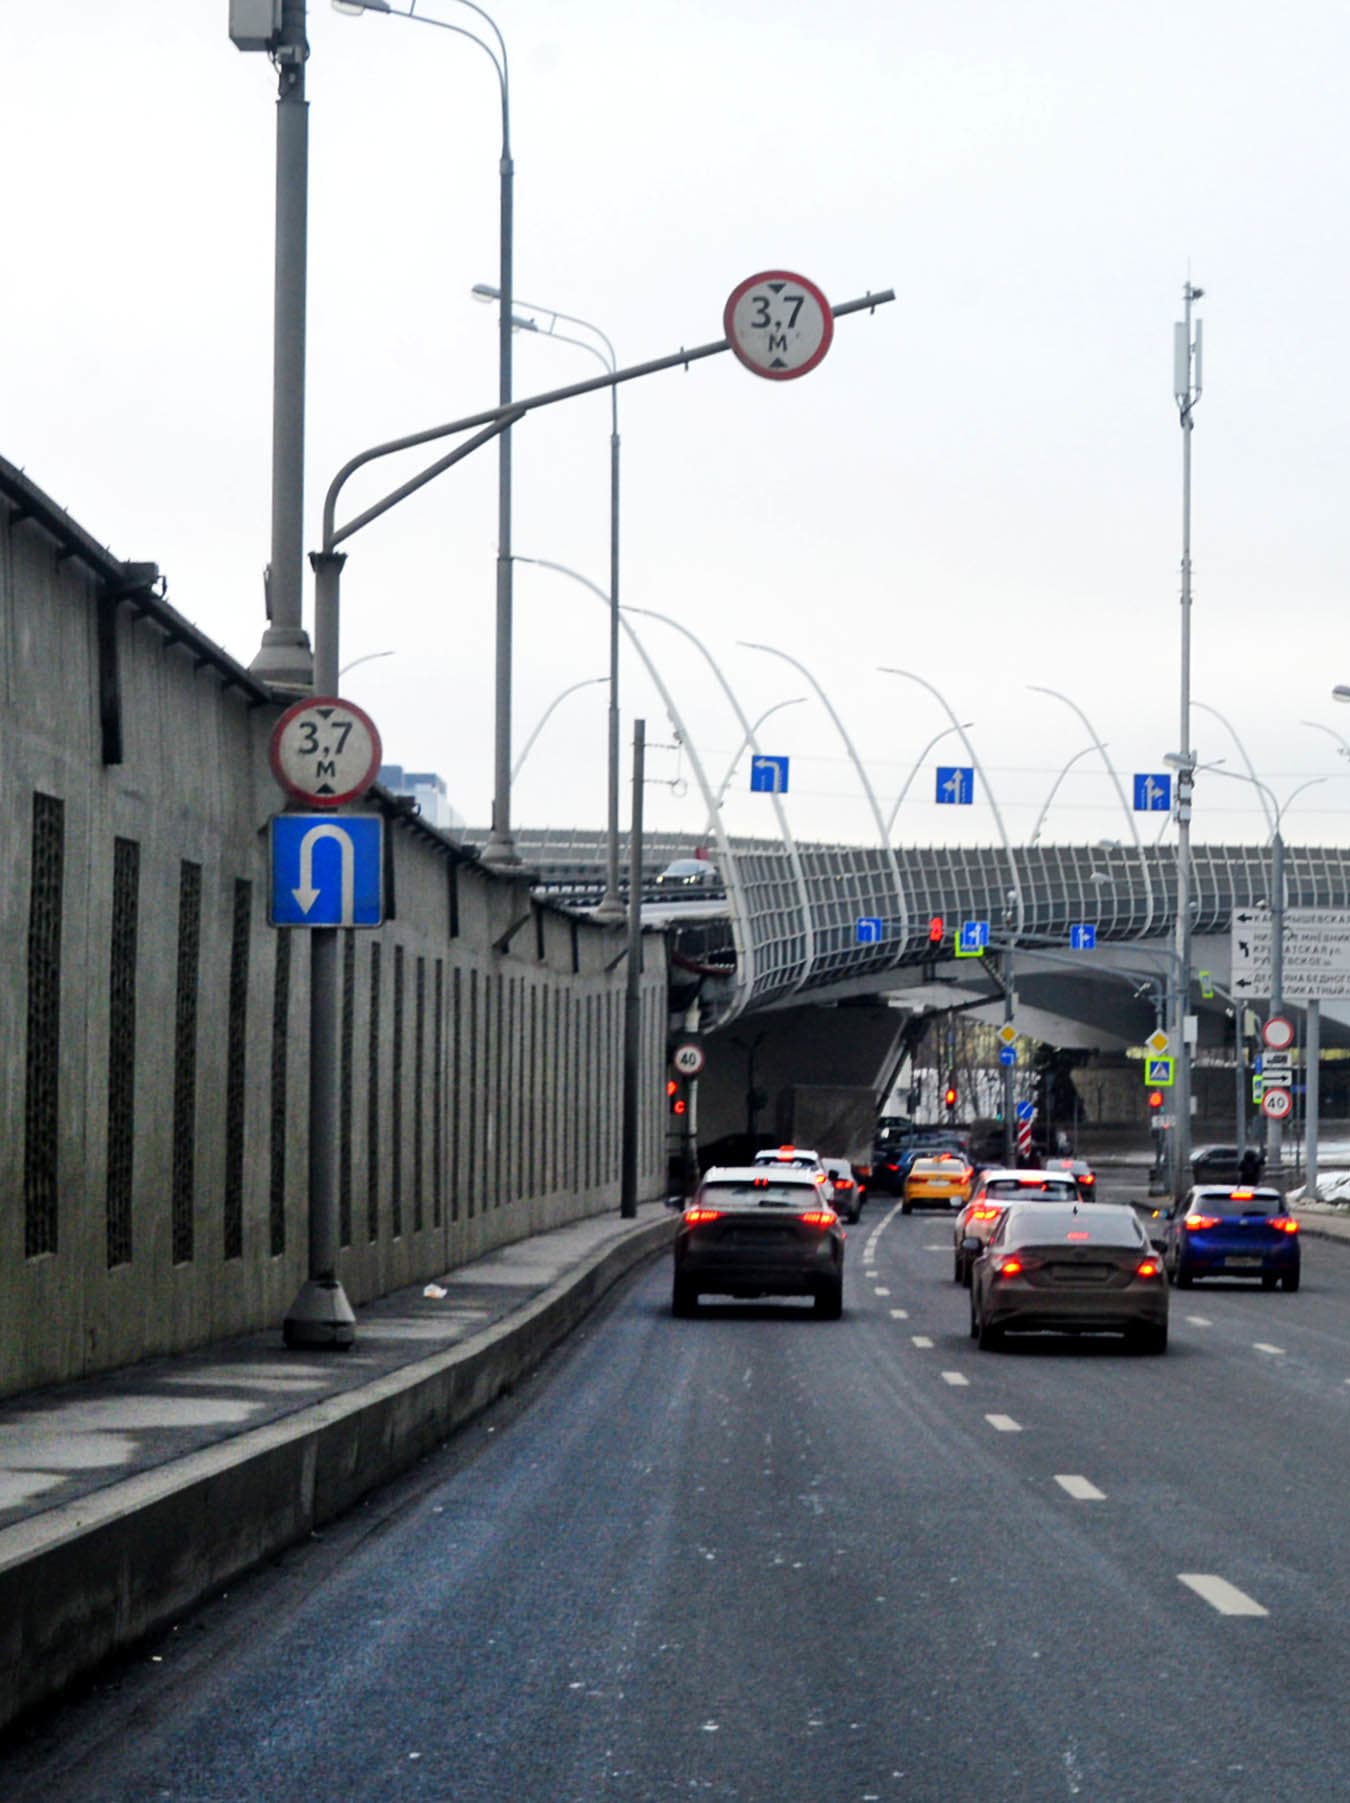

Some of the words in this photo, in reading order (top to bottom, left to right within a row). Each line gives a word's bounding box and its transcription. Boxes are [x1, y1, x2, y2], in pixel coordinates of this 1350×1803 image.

[752, 296, 804, 331] 3,7
[298, 720, 353, 758] 3,7
[681, 1052, 696, 1066] 40
[1267, 1097, 1285, 1108] 40
